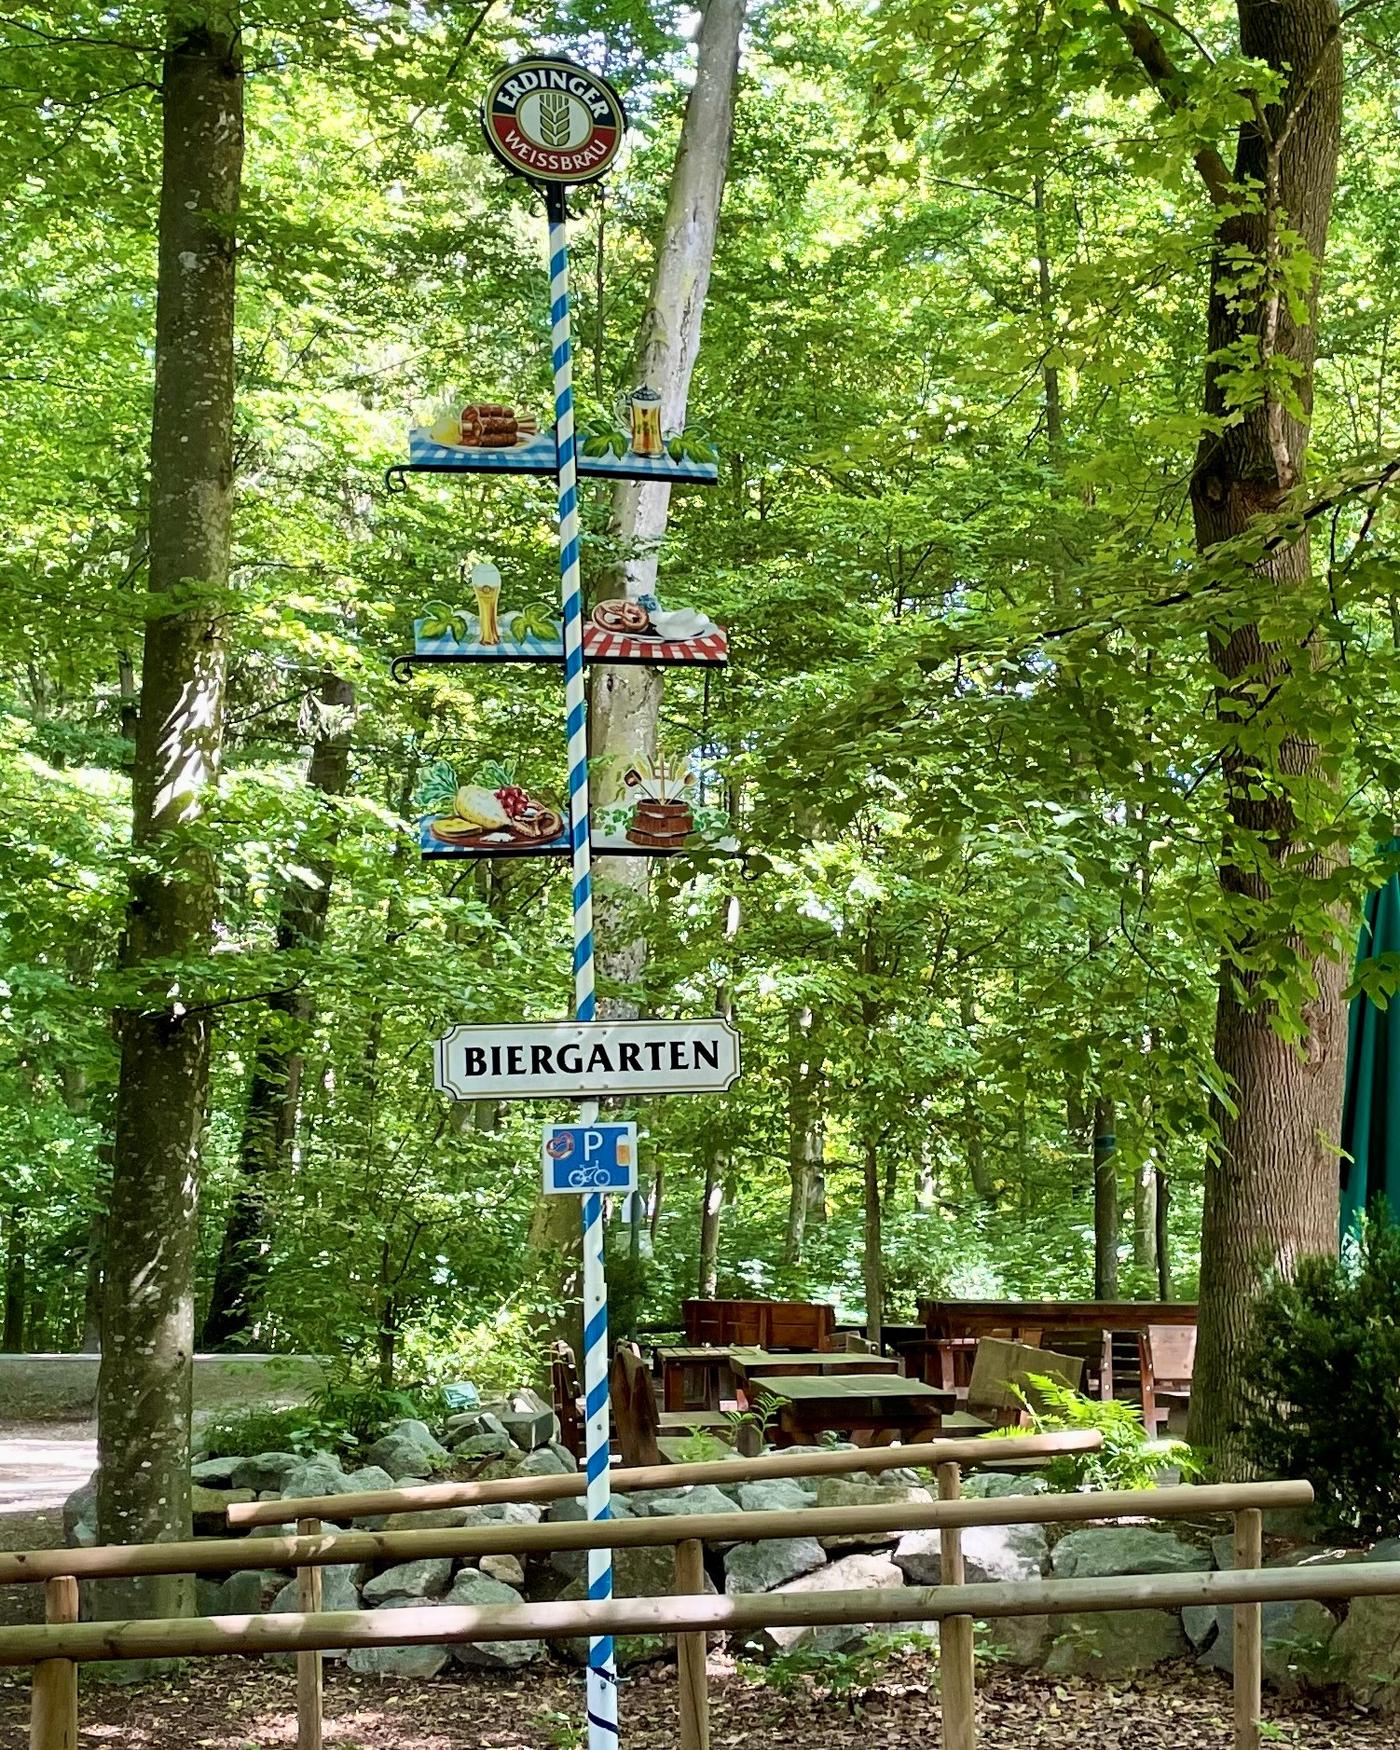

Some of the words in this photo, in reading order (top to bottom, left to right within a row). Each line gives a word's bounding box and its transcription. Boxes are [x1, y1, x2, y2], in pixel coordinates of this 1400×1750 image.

[496, 69, 609, 118] ERDINGER
[464, 1040, 719, 1077] BIERGARTEN
[583, 1131, 603, 1161] P
